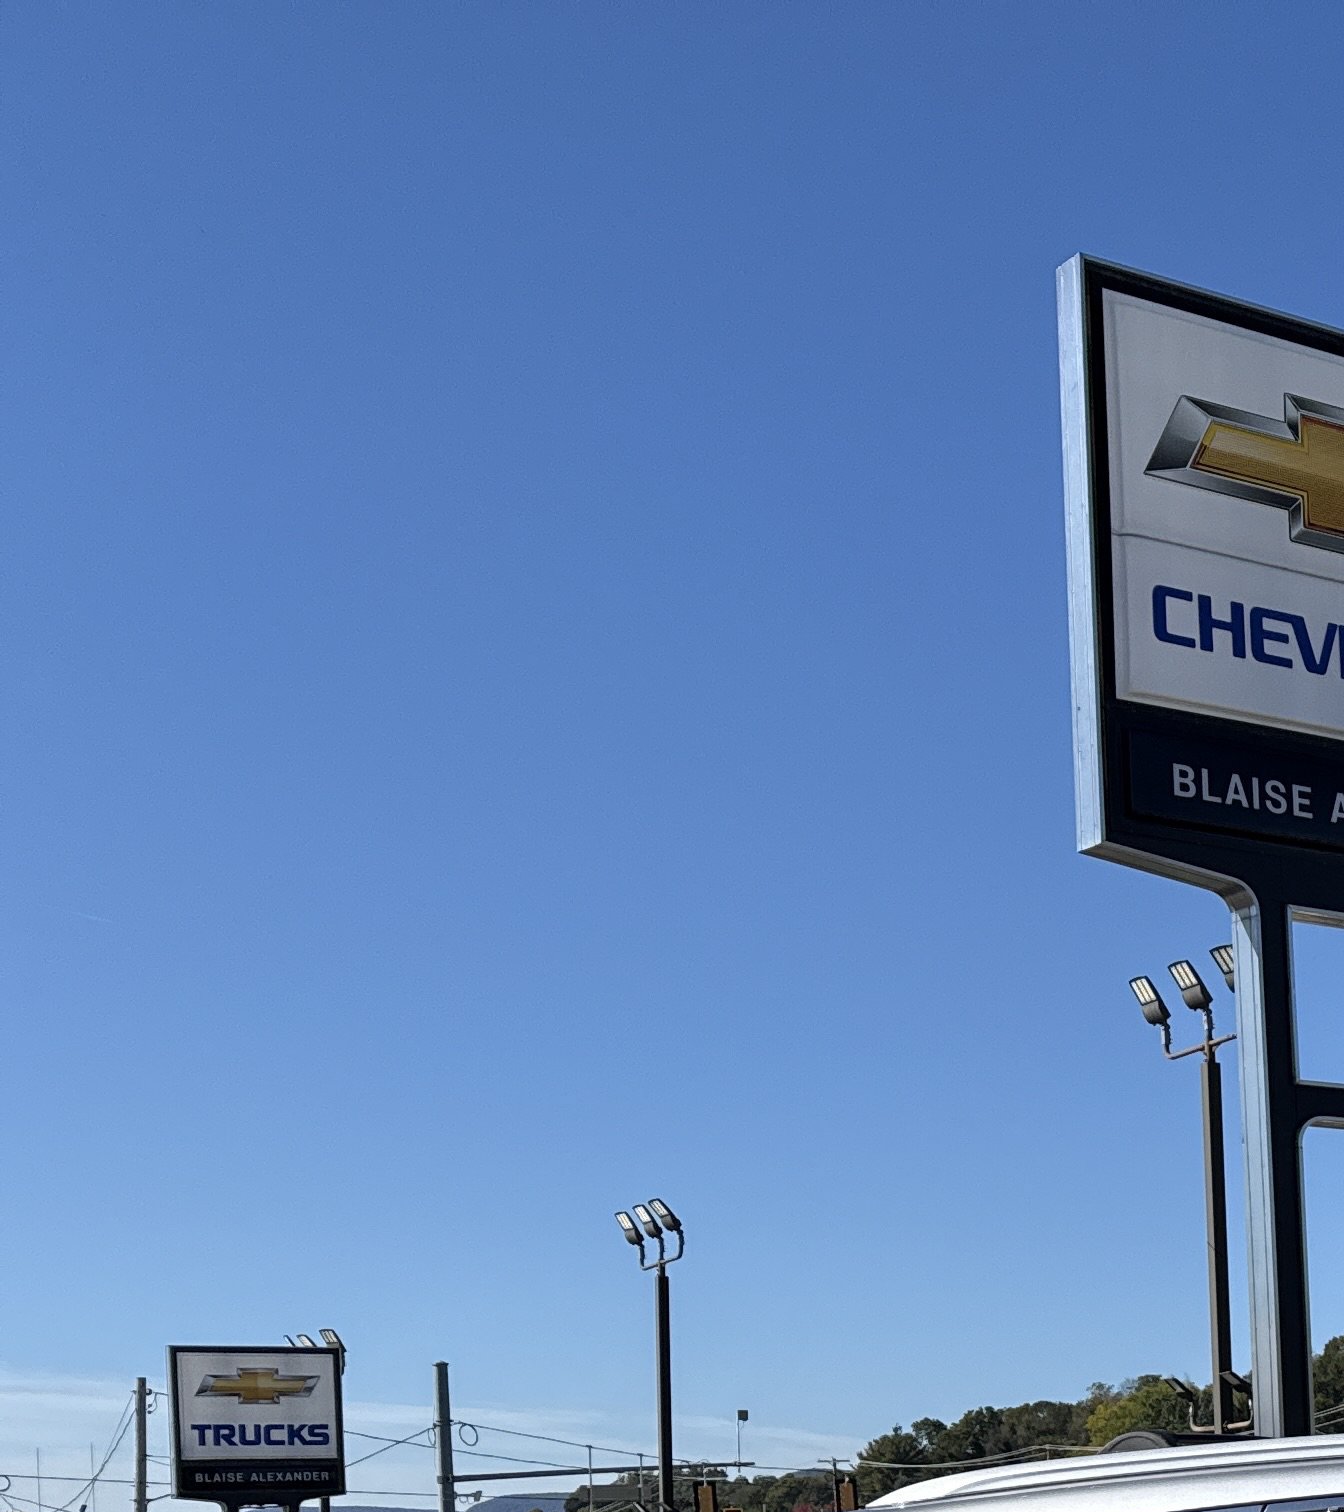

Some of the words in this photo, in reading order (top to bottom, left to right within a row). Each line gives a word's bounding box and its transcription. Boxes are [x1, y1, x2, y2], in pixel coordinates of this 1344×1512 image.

[1172, 762, 1314, 819] BLAISE
[190, 1423, 330, 1447] TRUCKS
[195, 1472, 244, 1483] BLAISE
[250, 1471, 330, 1482] ALEXANDER
